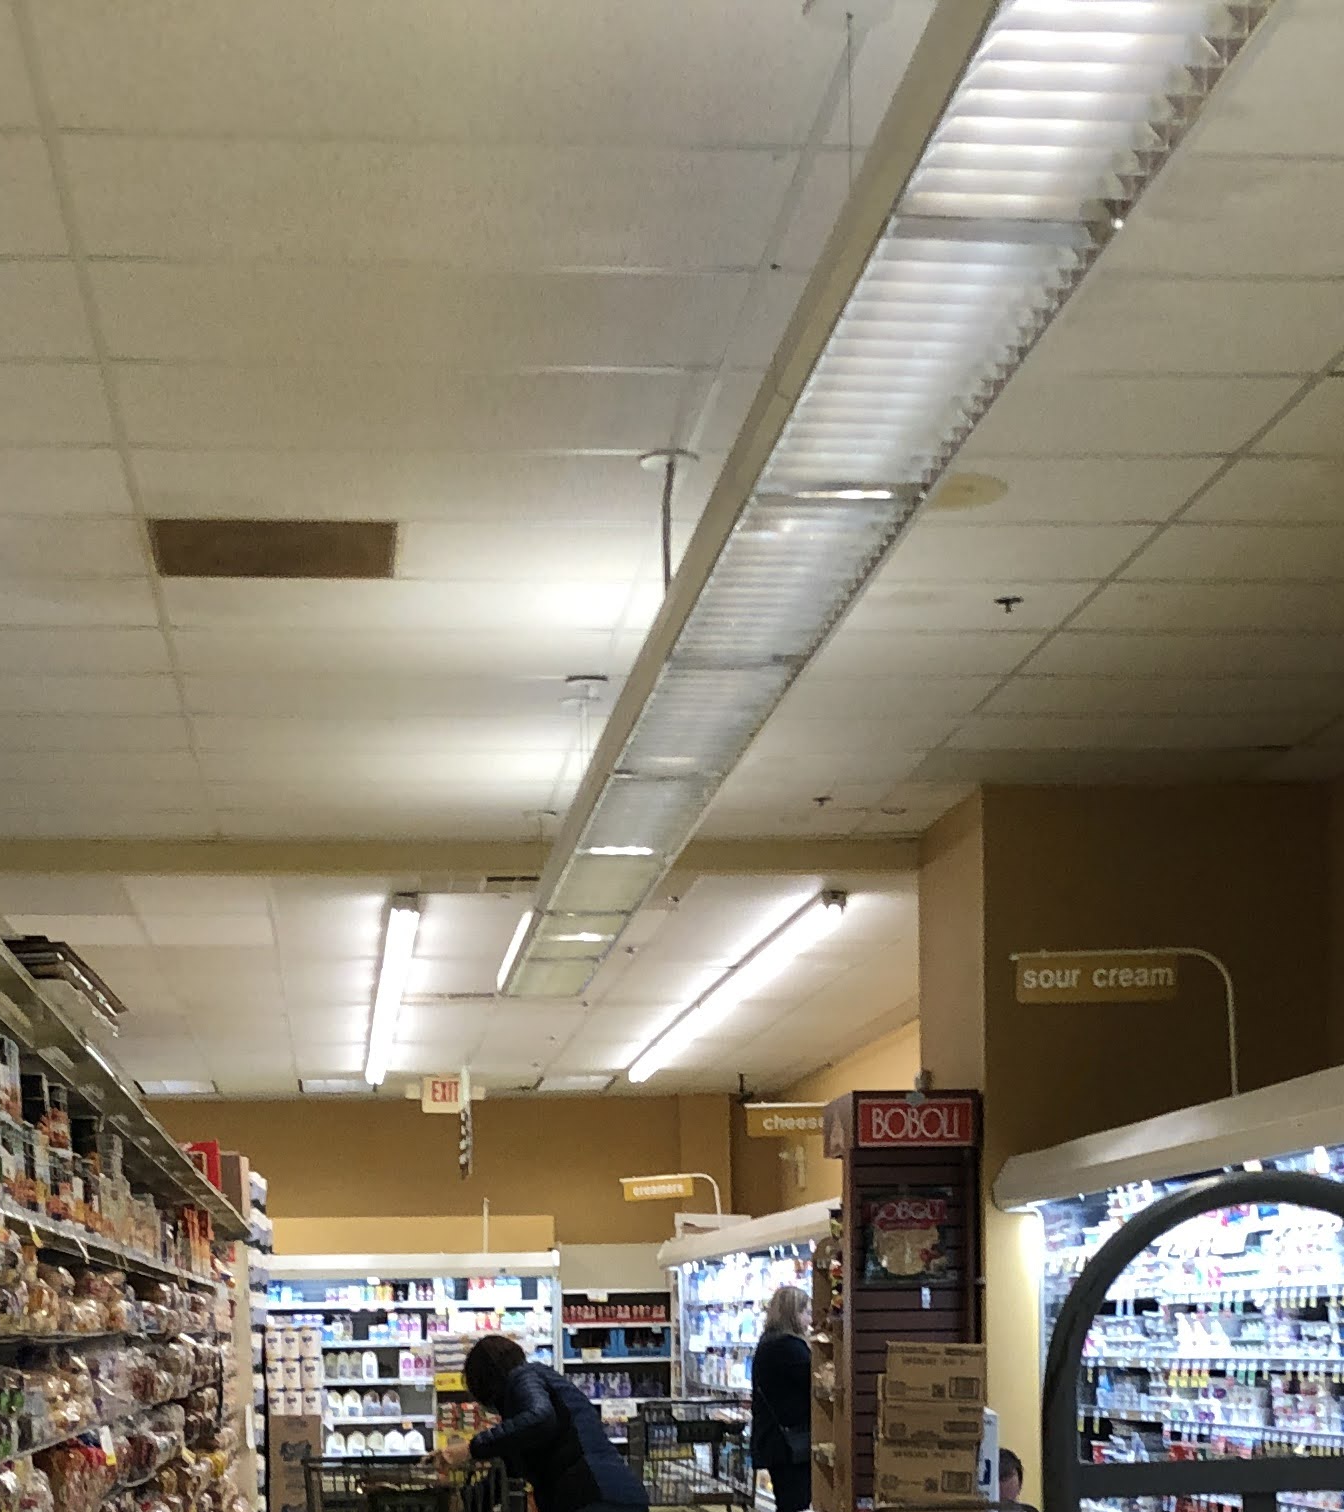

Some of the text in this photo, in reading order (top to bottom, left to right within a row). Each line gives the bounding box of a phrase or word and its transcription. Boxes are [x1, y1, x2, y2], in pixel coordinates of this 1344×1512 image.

[1023, 966, 1177, 989] sour cream
[871, 1107, 960, 1139] BOBOLI
